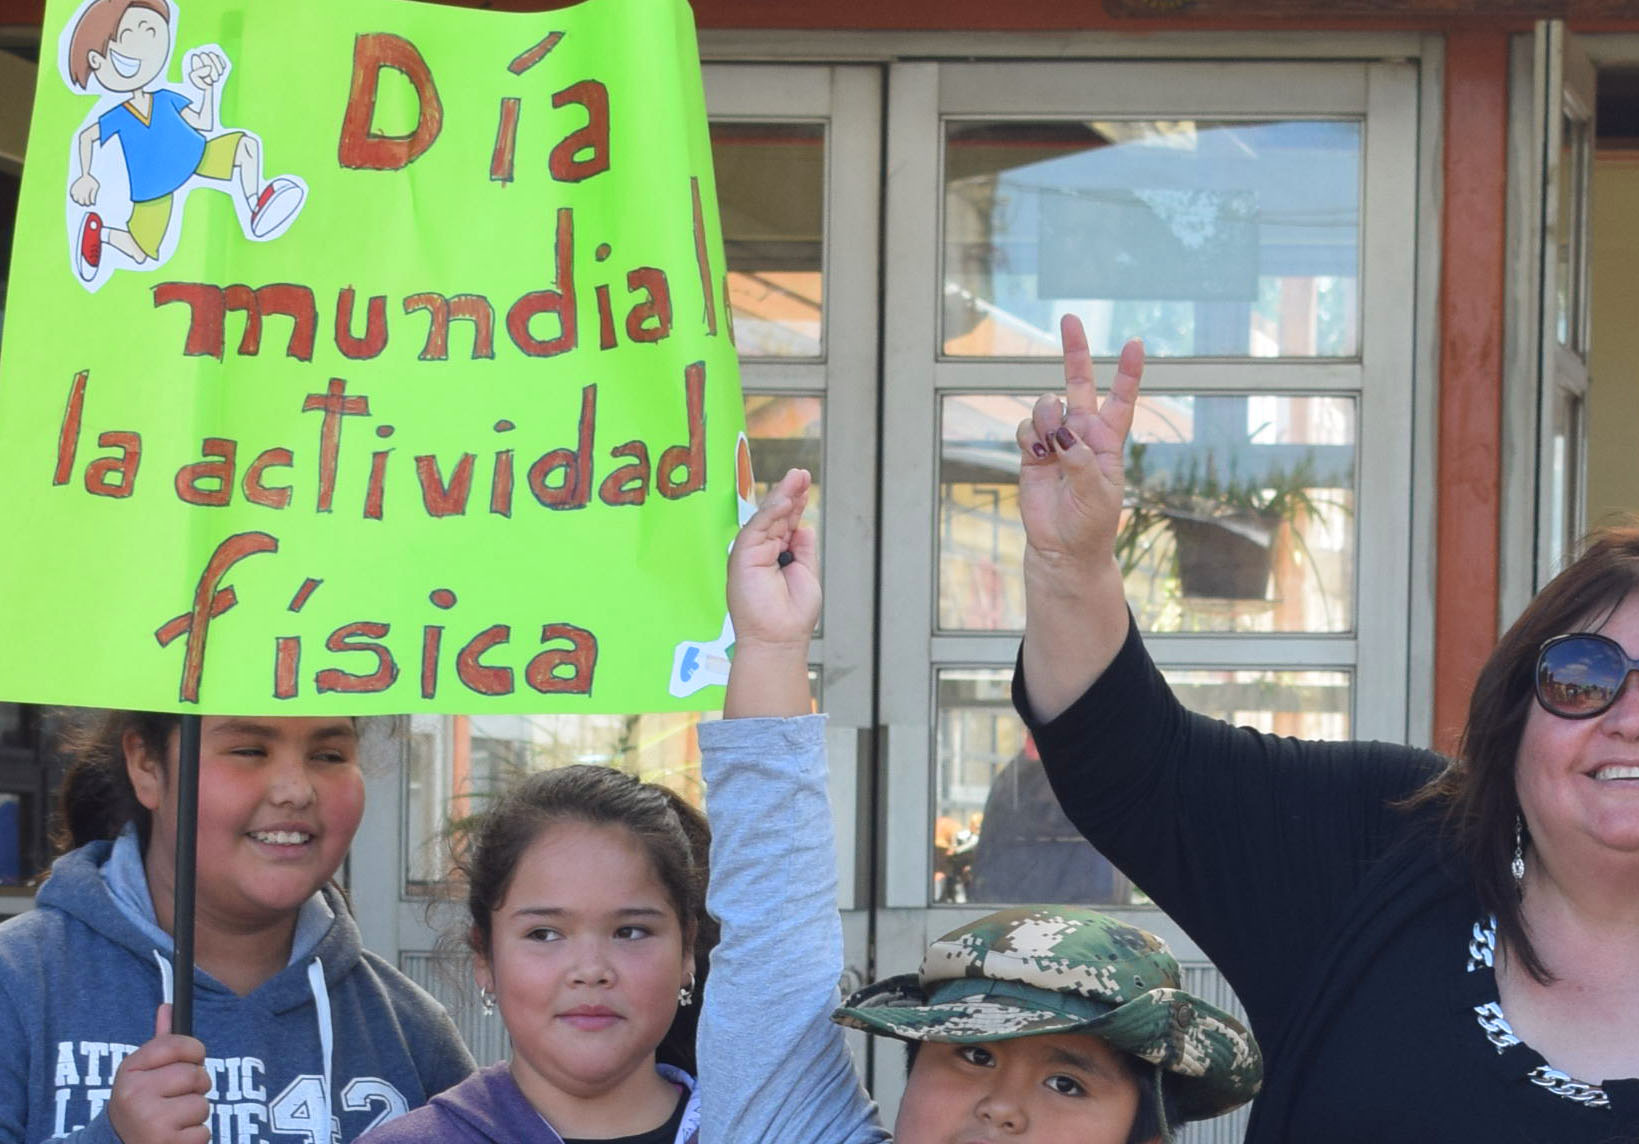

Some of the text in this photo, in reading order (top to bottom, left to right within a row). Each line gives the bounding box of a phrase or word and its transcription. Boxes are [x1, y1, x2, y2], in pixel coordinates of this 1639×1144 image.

[338, 31, 611, 188] Día
[152, 176, 718, 364] mundial
[52, 361, 707, 520] la actividad
[155, 531, 600, 703] física
